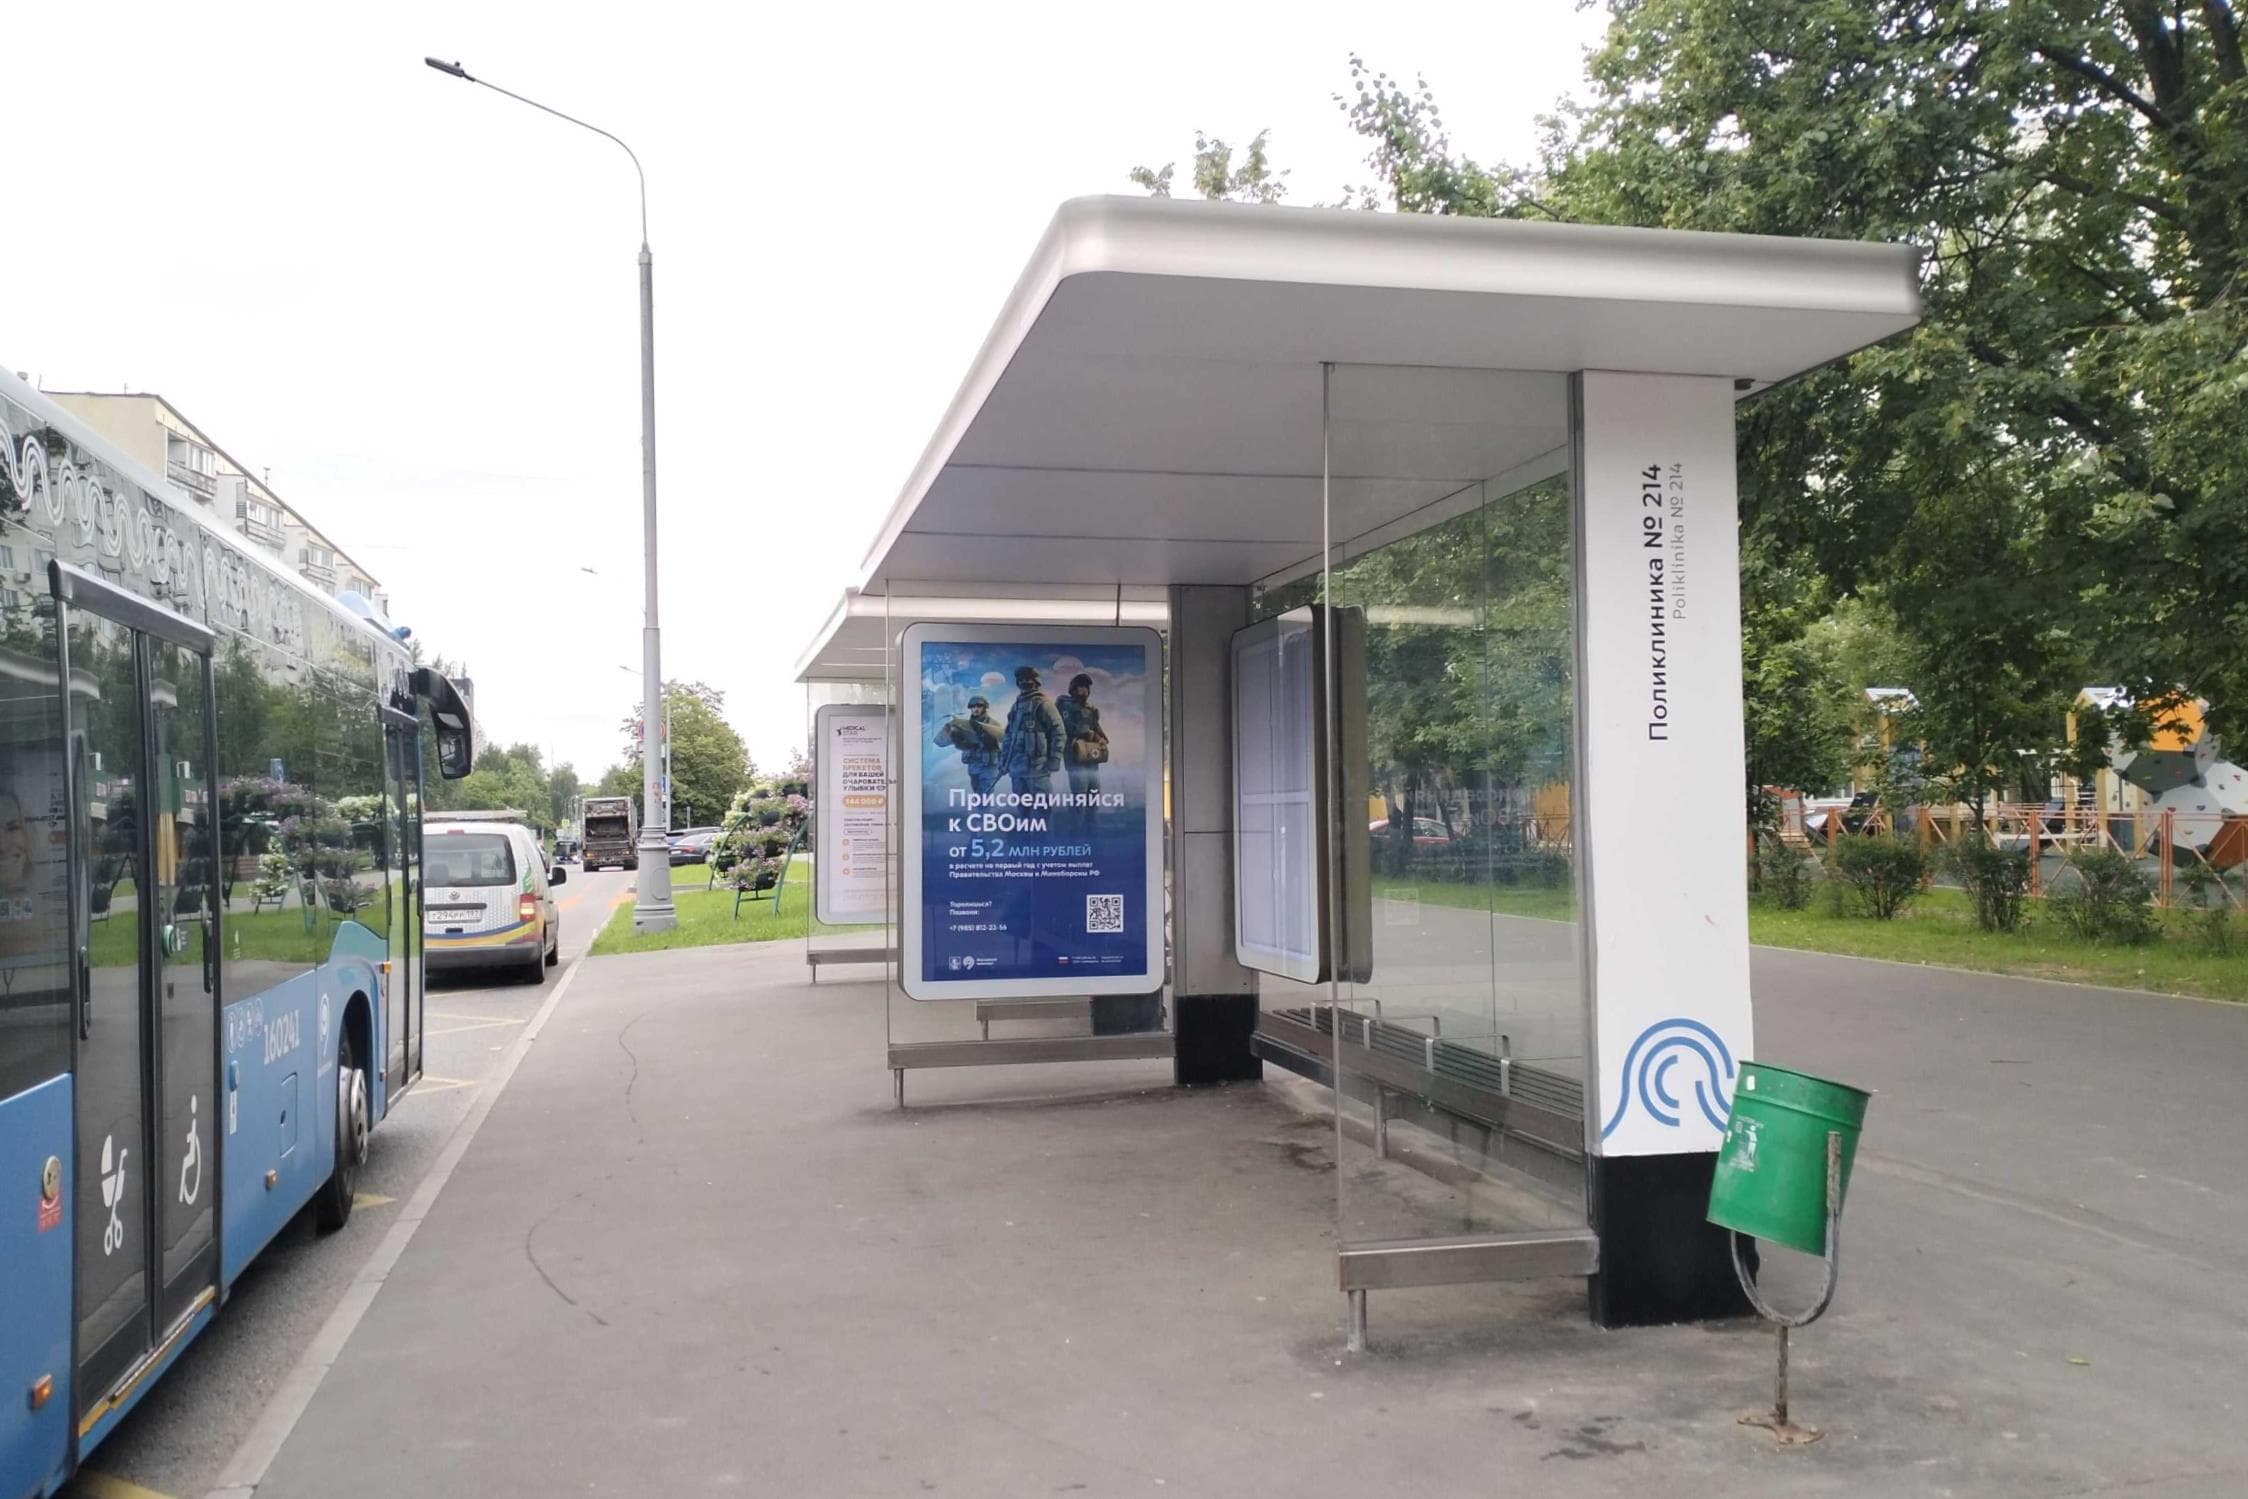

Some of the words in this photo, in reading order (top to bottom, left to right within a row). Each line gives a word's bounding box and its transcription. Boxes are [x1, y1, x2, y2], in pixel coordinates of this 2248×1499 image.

[1642, 464, 1662, 507] 214
[1669, 463, 1683, 490] 214
[1670, 496, 1684, 517] №
[1643, 516, 1663, 548] №
[1671, 524, 1686, 619] Poliklinika
[1648, 558, 1668, 740] Поликлиника
[949, 789, 1125, 810] Присоединяйся
[949, 818, 961, 832] к
[966, 813, 1047, 832] СВОим
[949, 846, 967, 858] от
[971, 839, 1005, 860] 5,2
[1008, 847, 1040, 857] МЛН
[1043, 844, 1092, 857] РУБЛЕЙ
[264, 1009, 300, 1066] 160241
